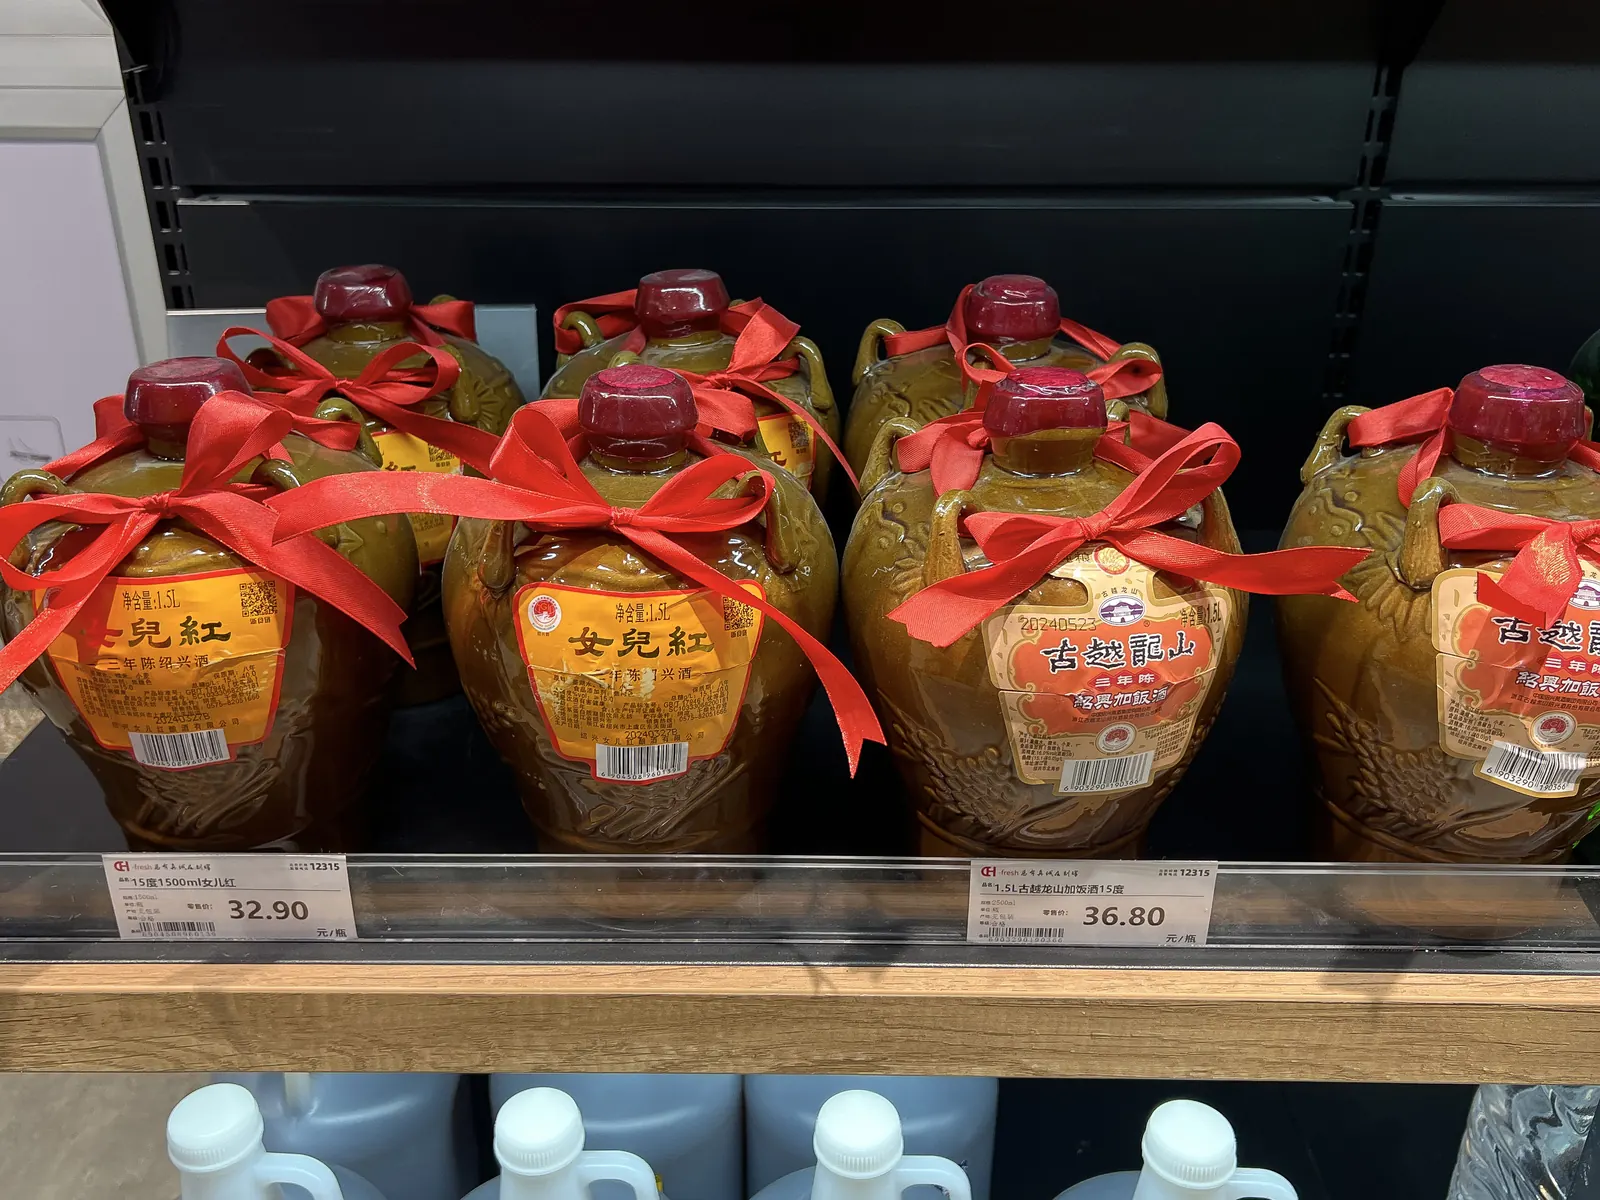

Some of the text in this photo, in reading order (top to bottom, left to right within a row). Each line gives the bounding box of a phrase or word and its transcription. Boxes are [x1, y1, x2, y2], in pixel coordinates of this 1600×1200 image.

[122, 589, 181, 611] 净含量:1.5L
[615, 602, 671, 624] 净含量:1.5L
[1020, 616, 1098, 633] 20240523
[568, 625, 714, 658] 女兒紅
[1041, 630, 1196, 675] 古越龍山
[108, 654, 209, 671] 三年陈绍兴酒
[597, 666, 692, 682] 三年陈兴酒
[1095, 673, 1155, 687] 三年陈
[1073, 685, 1169, 710] 紹興加飯酒
[624, 728, 678, 740] 20240327B
[1486, 766, 1493, 774] 6
[1498, 770, 1534, 788] 903290
[1074, 783, 1105, 792] 903290
[309, 862, 340, 871] 12315
[1180, 869, 1210, 877] 12315
[132, 878, 237, 888] 15度1500ml女儿红
[995, 884, 1125, 895] 1.5L古越龙山加饭酒15度
[228, 900, 309, 920] 32.90
[1083, 906, 1165, 927] 36.80
[316, 928, 347, 937] 元/瓶
[1166, 934, 1197, 943] 元/瓶
